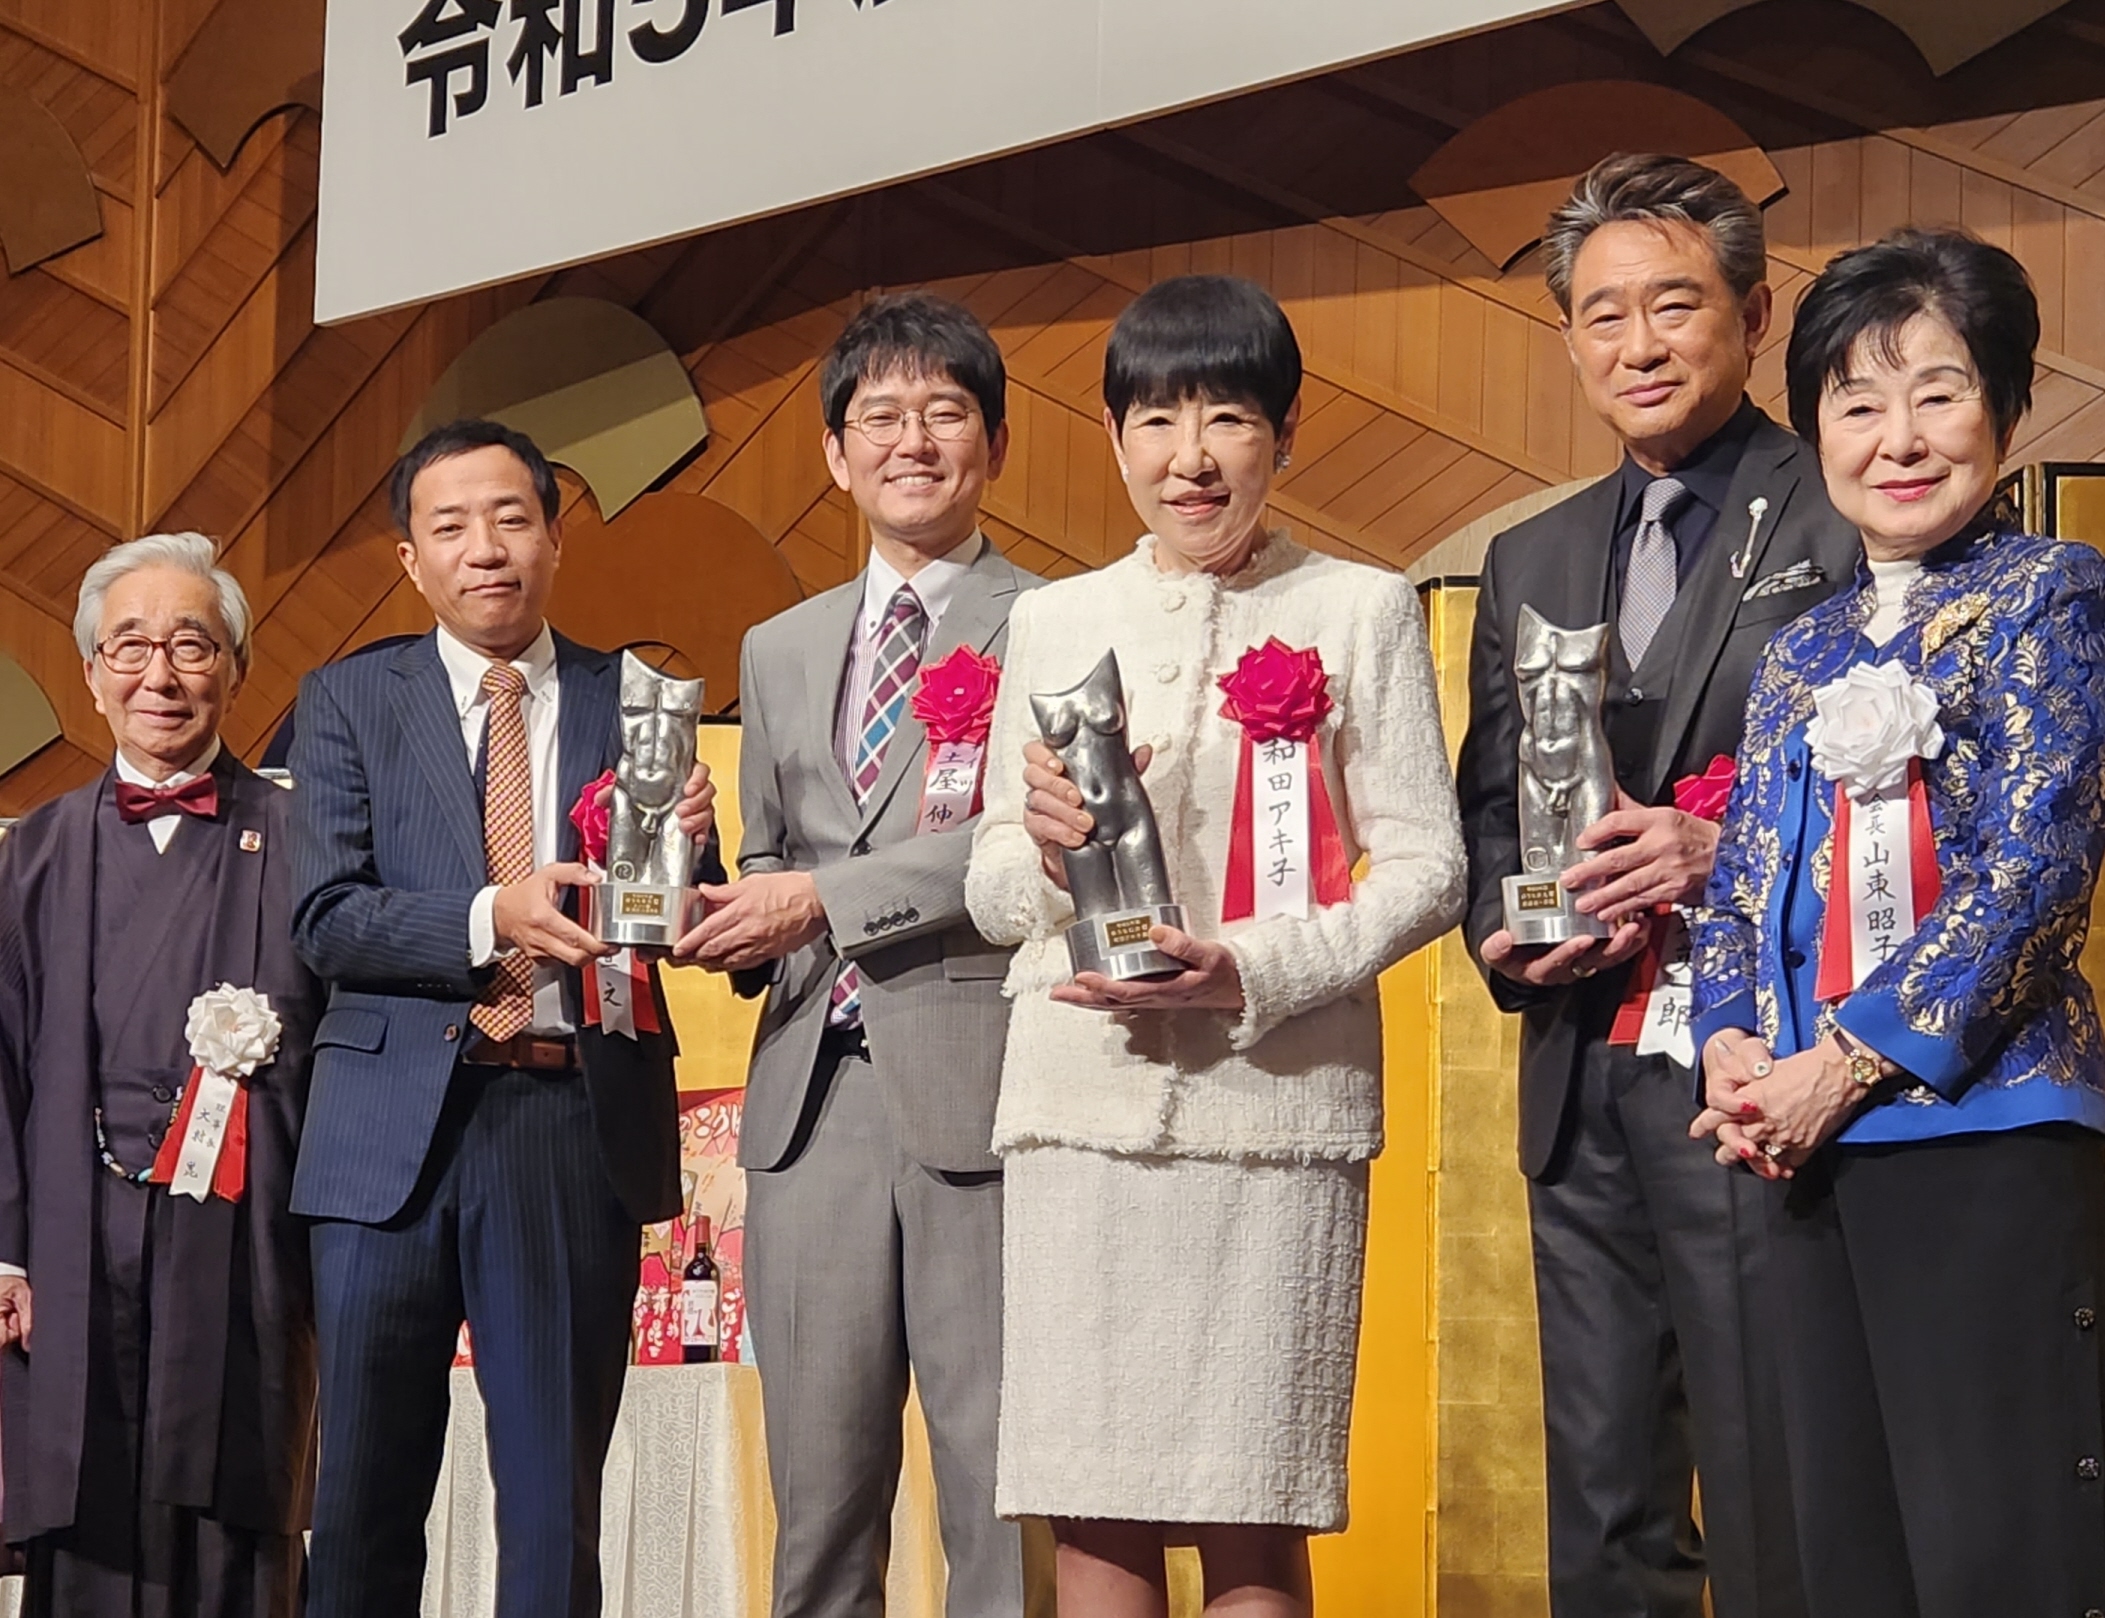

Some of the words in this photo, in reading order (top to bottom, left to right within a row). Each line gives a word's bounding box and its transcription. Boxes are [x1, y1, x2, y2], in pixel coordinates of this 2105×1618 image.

[396, 0, 888, 138] 令和5
[925, 751, 964, 834] 土屋伸
[961, 743, 982, 796] イツ
[1262, 738, 1297, 887] 和田アキ子
[1863, 841, 1900, 961] 山東昭子
